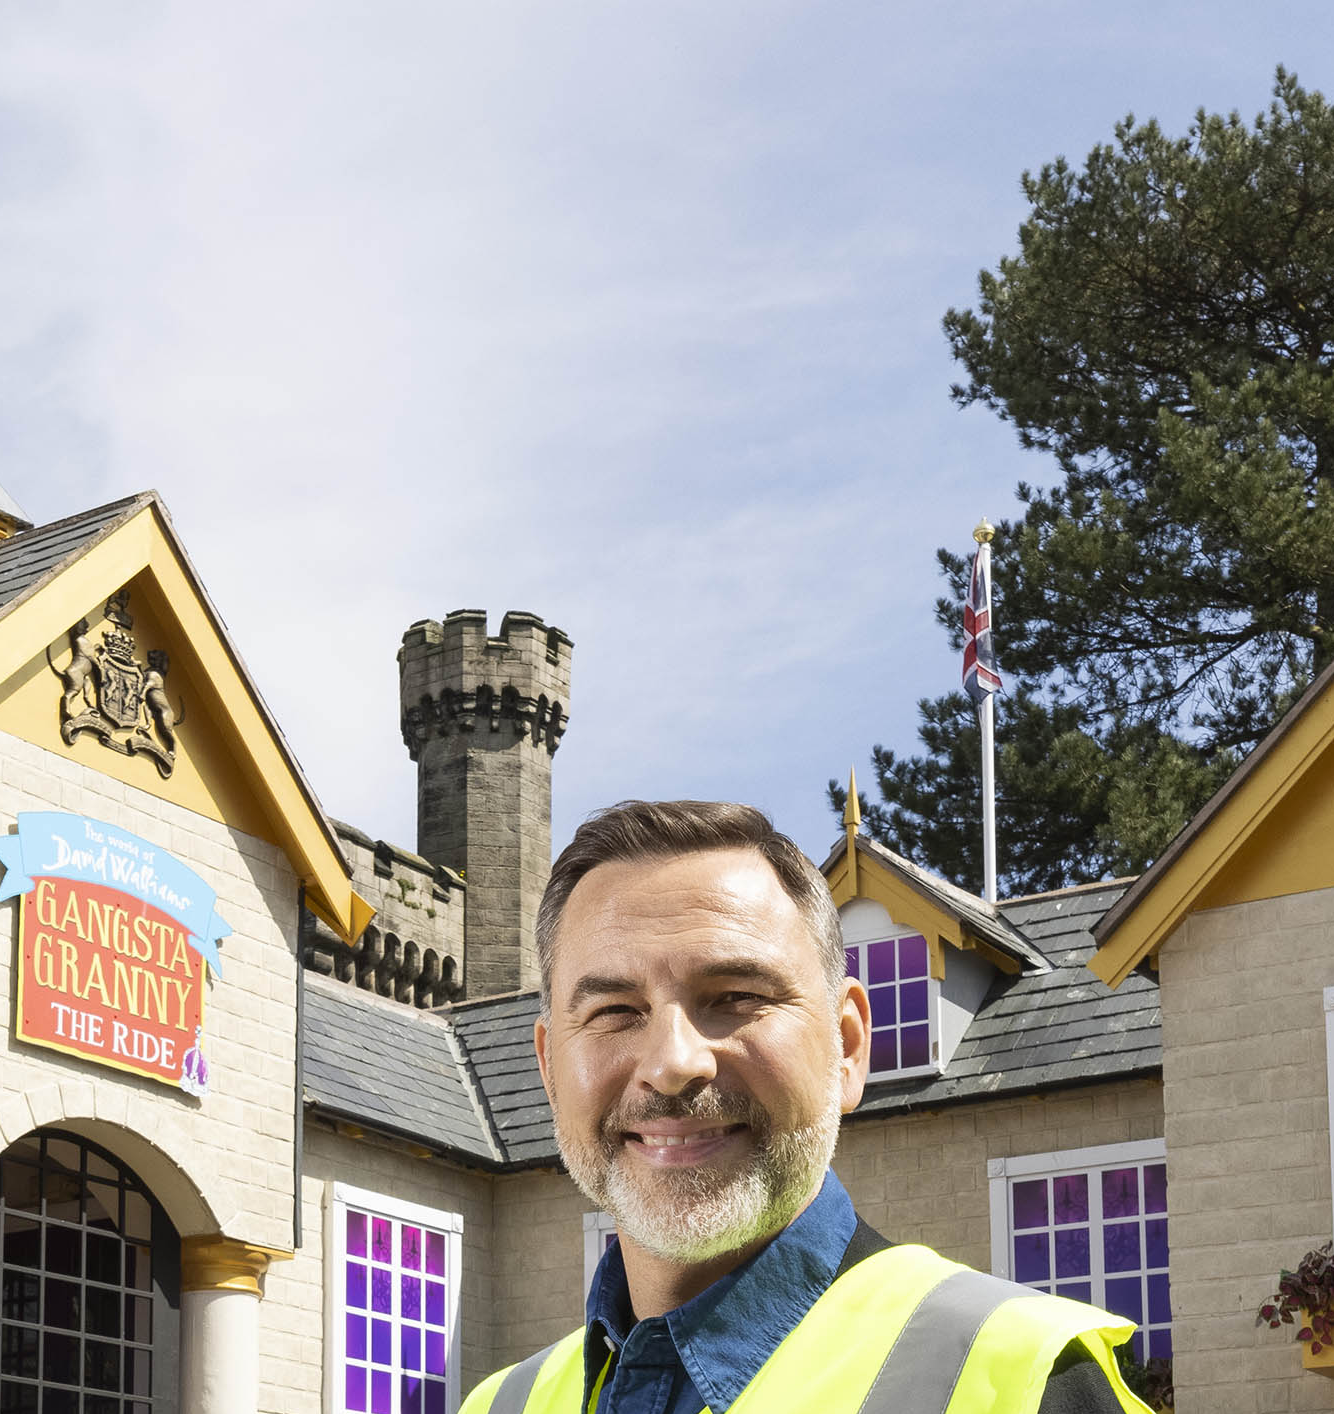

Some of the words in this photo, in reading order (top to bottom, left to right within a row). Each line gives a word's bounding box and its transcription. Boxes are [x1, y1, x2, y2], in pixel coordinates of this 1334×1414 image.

[42, 833, 108, 881] David
[109, 853, 192, 910] Walliams
[83, 820, 104, 843] The
[107, 836, 140, 858] world
[142, 851, 156, 865] of
[35, 879, 194, 978] GANGSTA
[33, 931, 193, 1032] GRANNY
[50, 1001, 105, 1048] THE
[112, 1020, 177, 1070] RIDE
